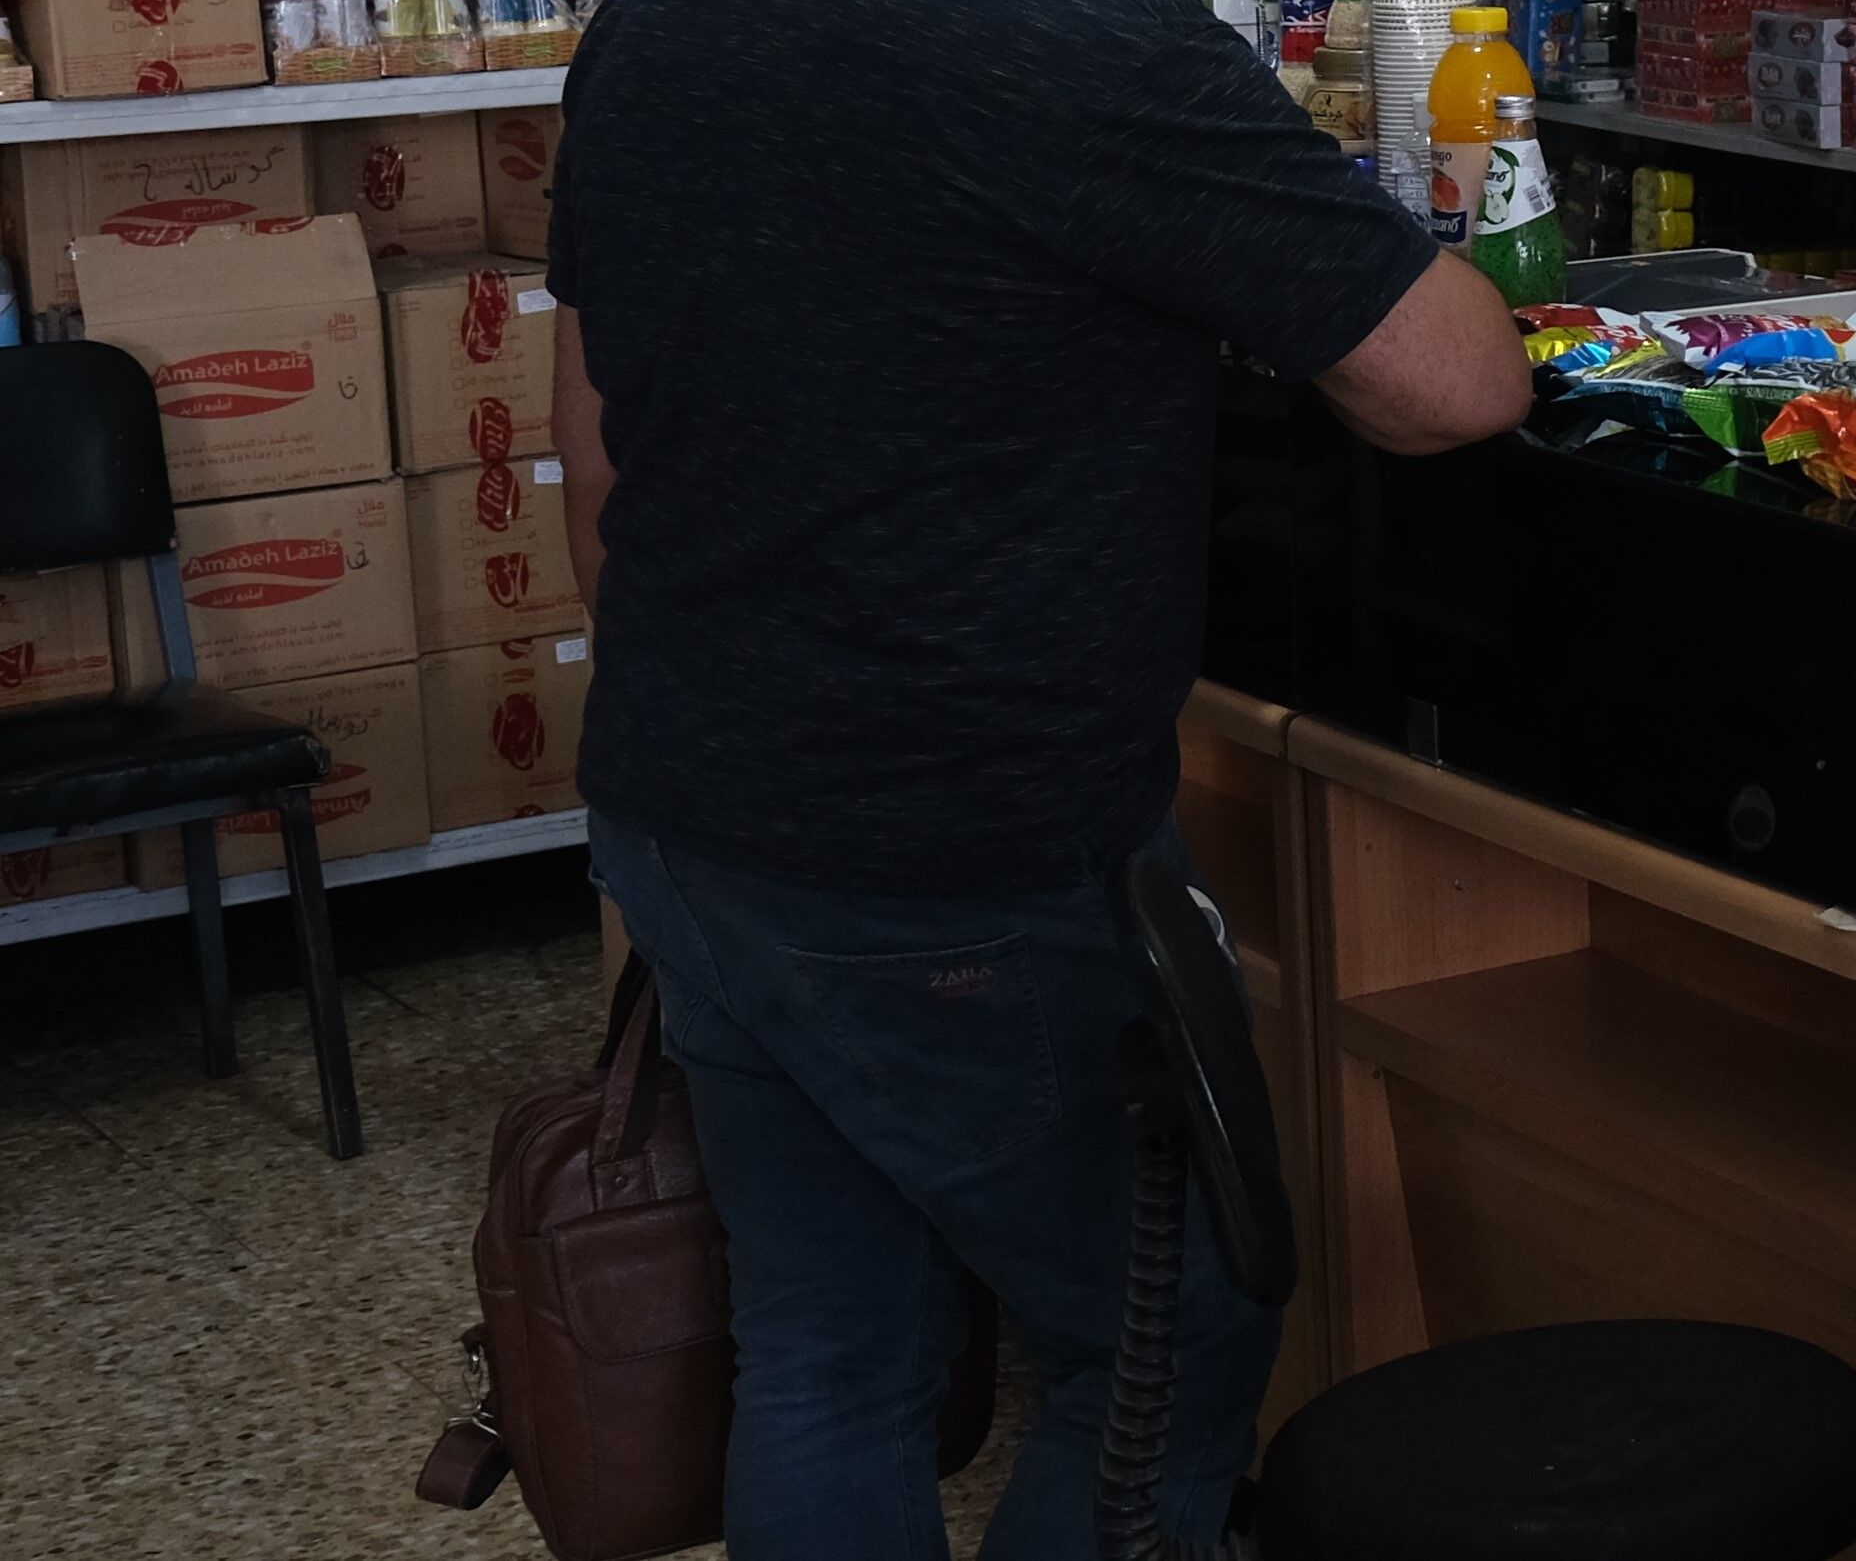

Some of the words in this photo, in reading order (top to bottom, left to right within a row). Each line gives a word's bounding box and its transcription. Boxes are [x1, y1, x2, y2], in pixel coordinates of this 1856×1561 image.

[155, 354, 248, 384] Amadeh
[254, 350, 310, 373] Laziz
[188, 545, 281, 576] Amadeh
[285, 539, 340, 563] Laziz
